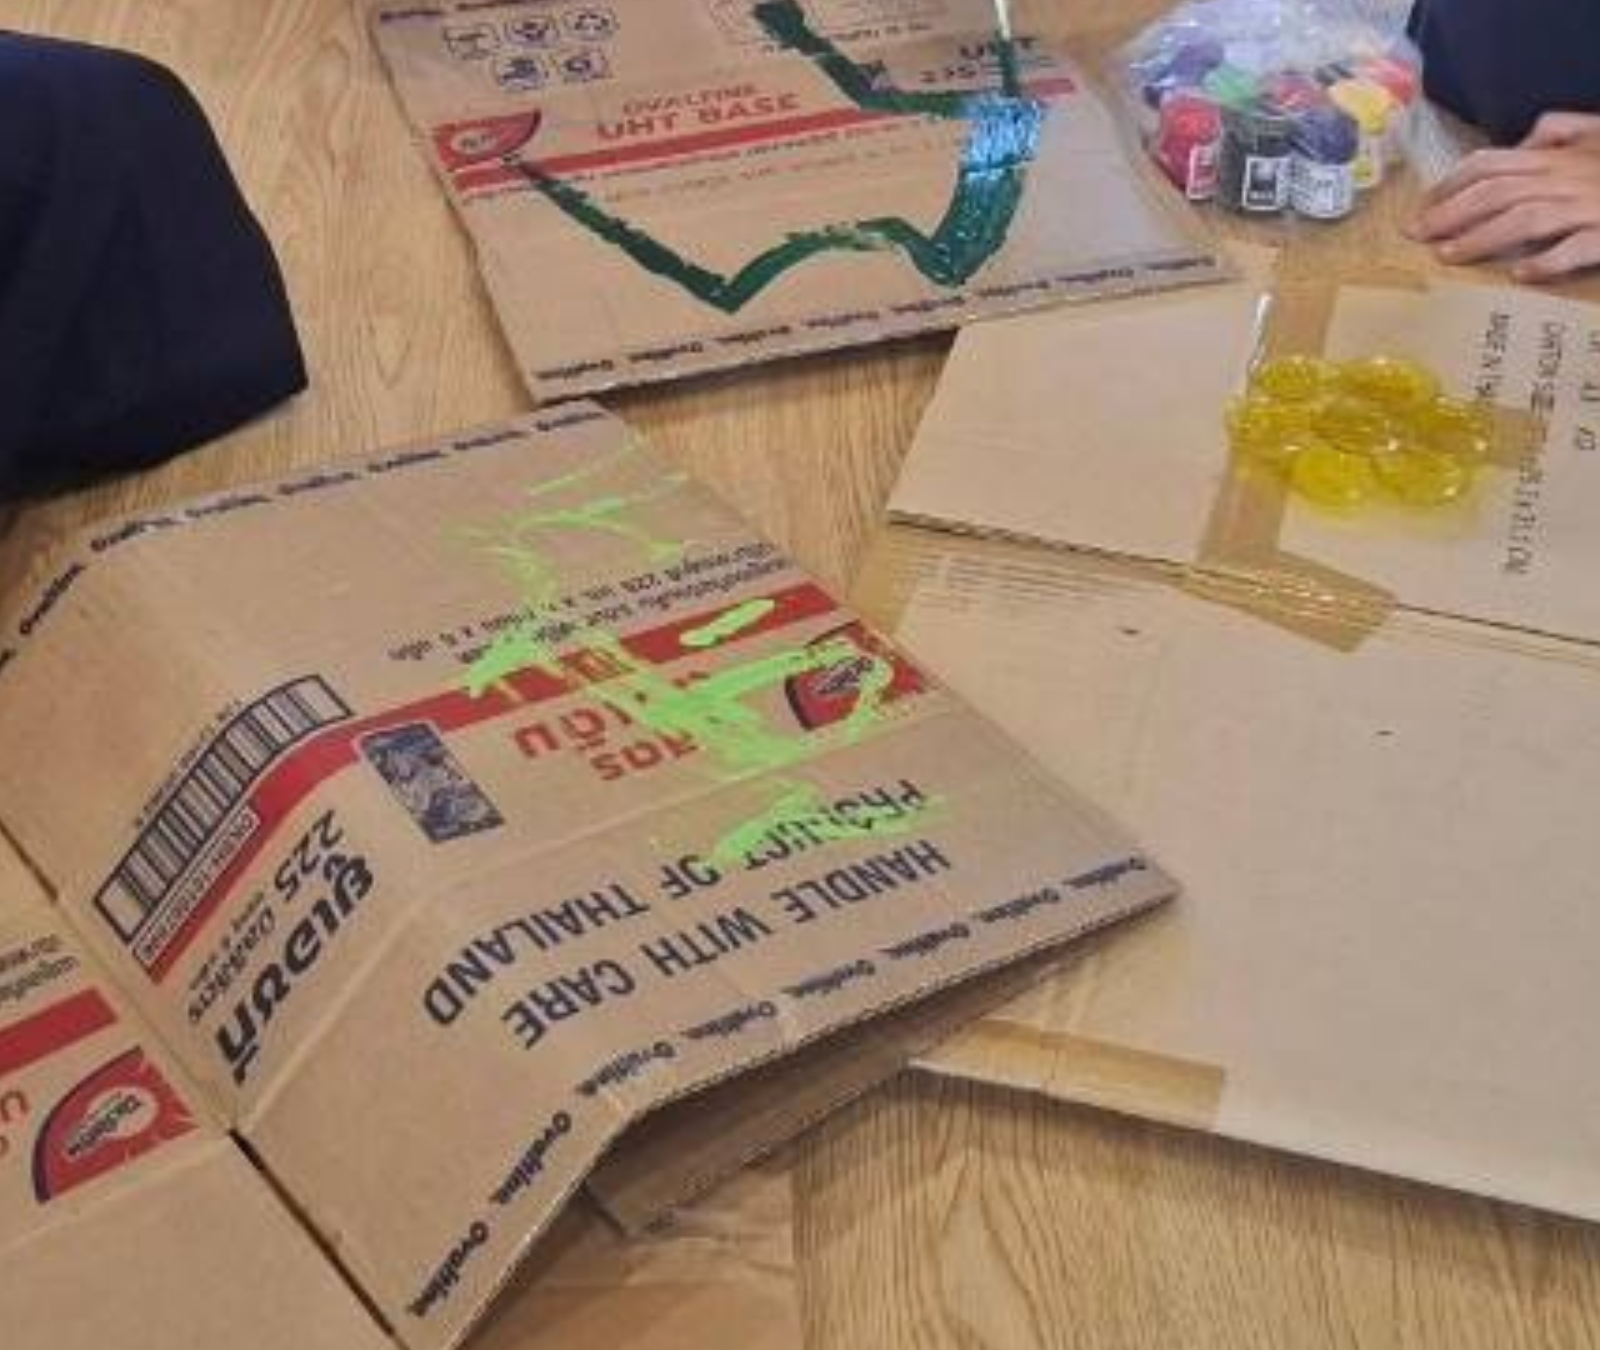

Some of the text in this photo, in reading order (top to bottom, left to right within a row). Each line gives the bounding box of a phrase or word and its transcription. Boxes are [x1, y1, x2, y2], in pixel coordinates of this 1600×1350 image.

[597, 91, 800, 144] UHT BASE
[275, 810, 344, 901] 225
[217, 857, 373, 1084] ยูเอชที
[423, 883, 649, 1027] THAILAND
[500, 840, 952, 1049] HANDLE WITH CARE
